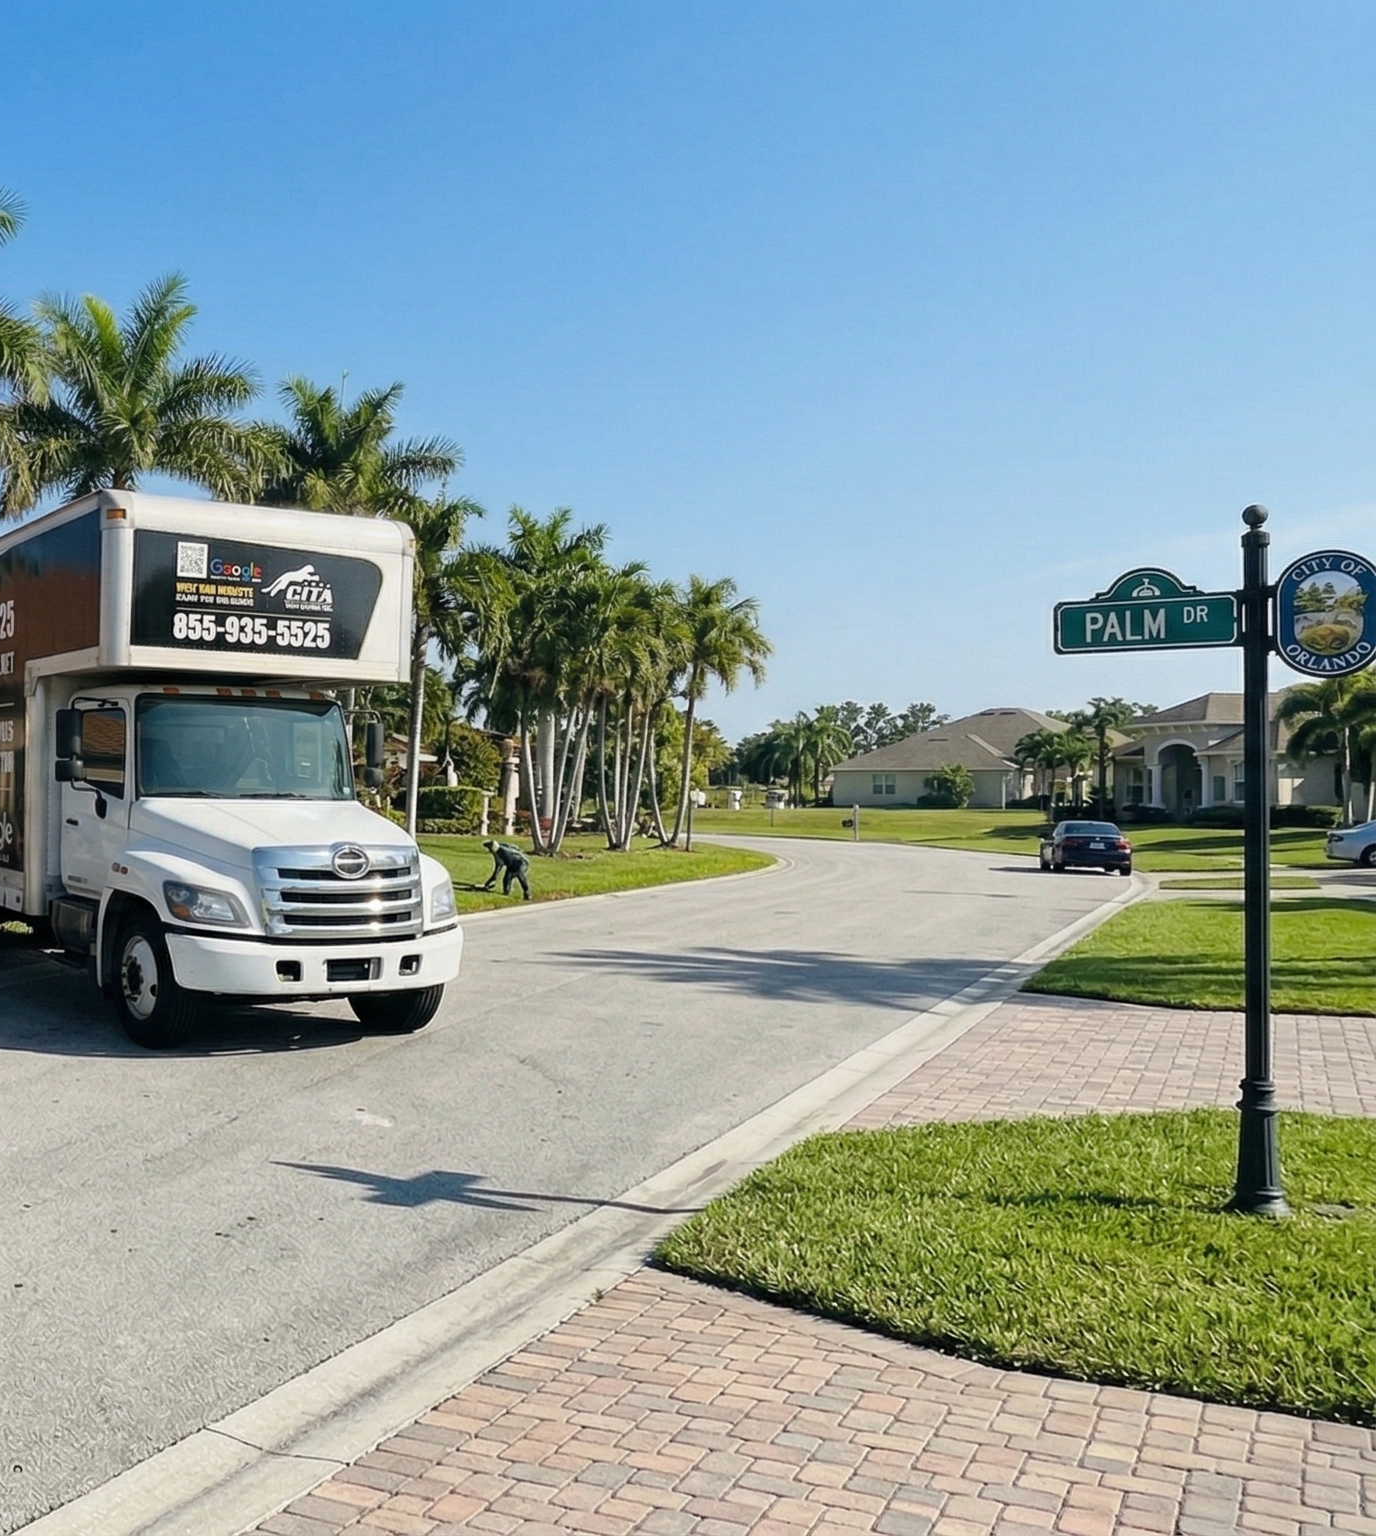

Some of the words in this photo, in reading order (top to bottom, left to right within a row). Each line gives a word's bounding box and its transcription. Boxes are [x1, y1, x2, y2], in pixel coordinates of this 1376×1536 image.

[1292, 558, 1333, 581] CITY
[1340, 559, 1367, 576] OF
[285, 585, 333, 604] CITA
[173, 612, 331, 649] 855-935-5525
[1085, 608, 1166, 643] PALM
[1183, 605, 1209, 624] DR
[1286, 641, 1371, 670] ORLANDO
